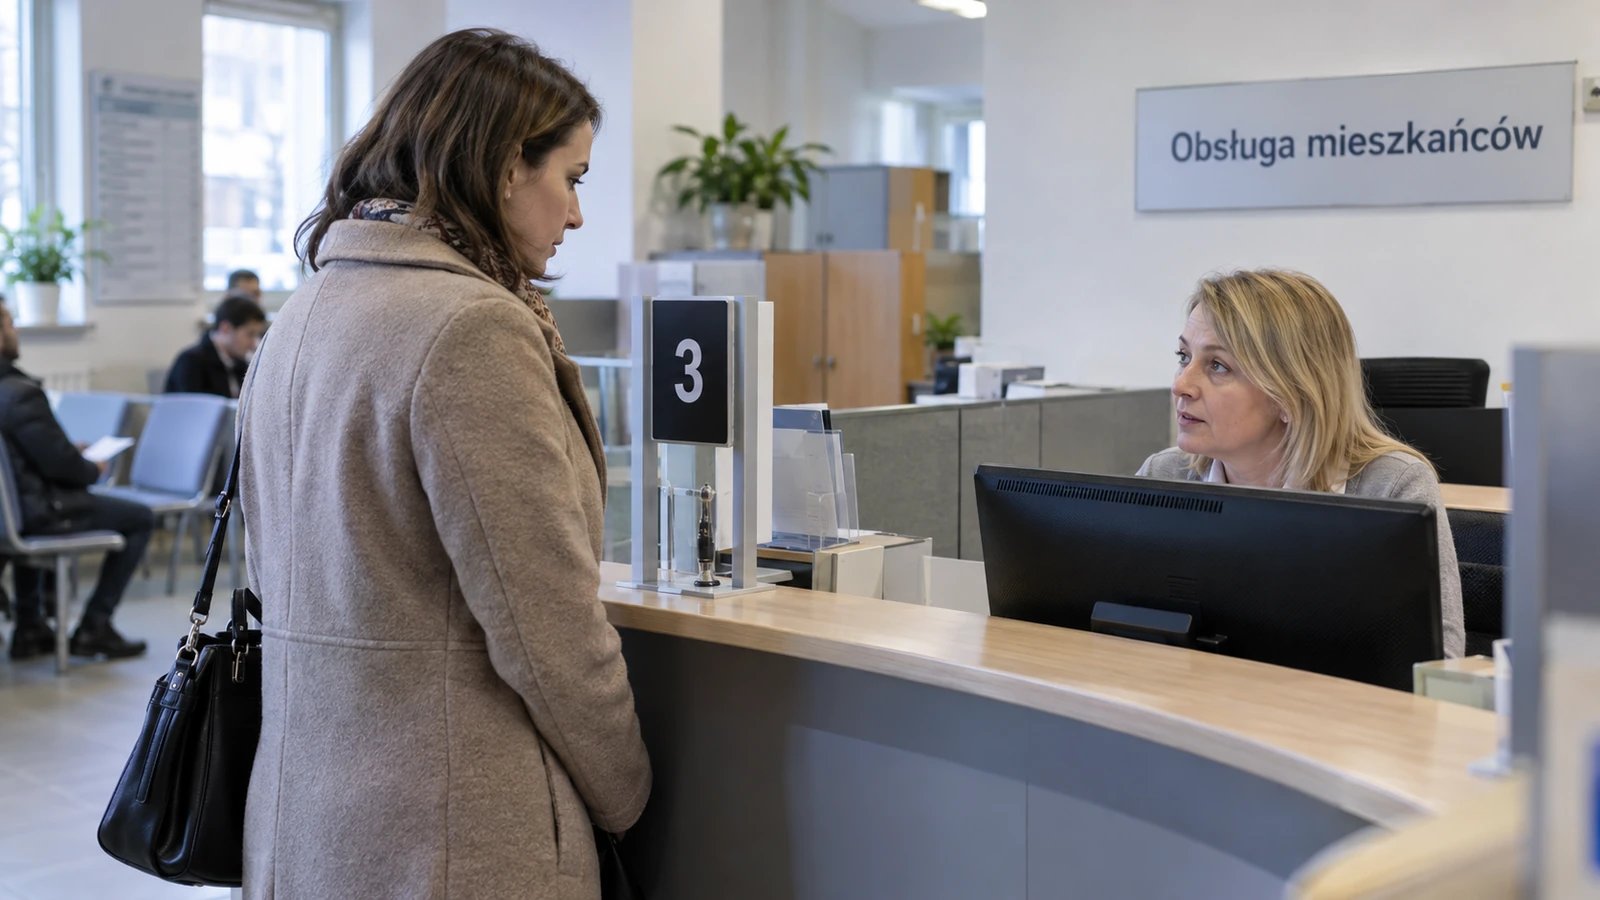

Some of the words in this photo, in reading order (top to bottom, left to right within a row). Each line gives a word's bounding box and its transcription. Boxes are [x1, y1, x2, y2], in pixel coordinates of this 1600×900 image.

[1171, 129, 1295, 168] Obsługa
[1307, 115, 1544, 158] mieszkańców
[674, 338, 704, 404] 3
